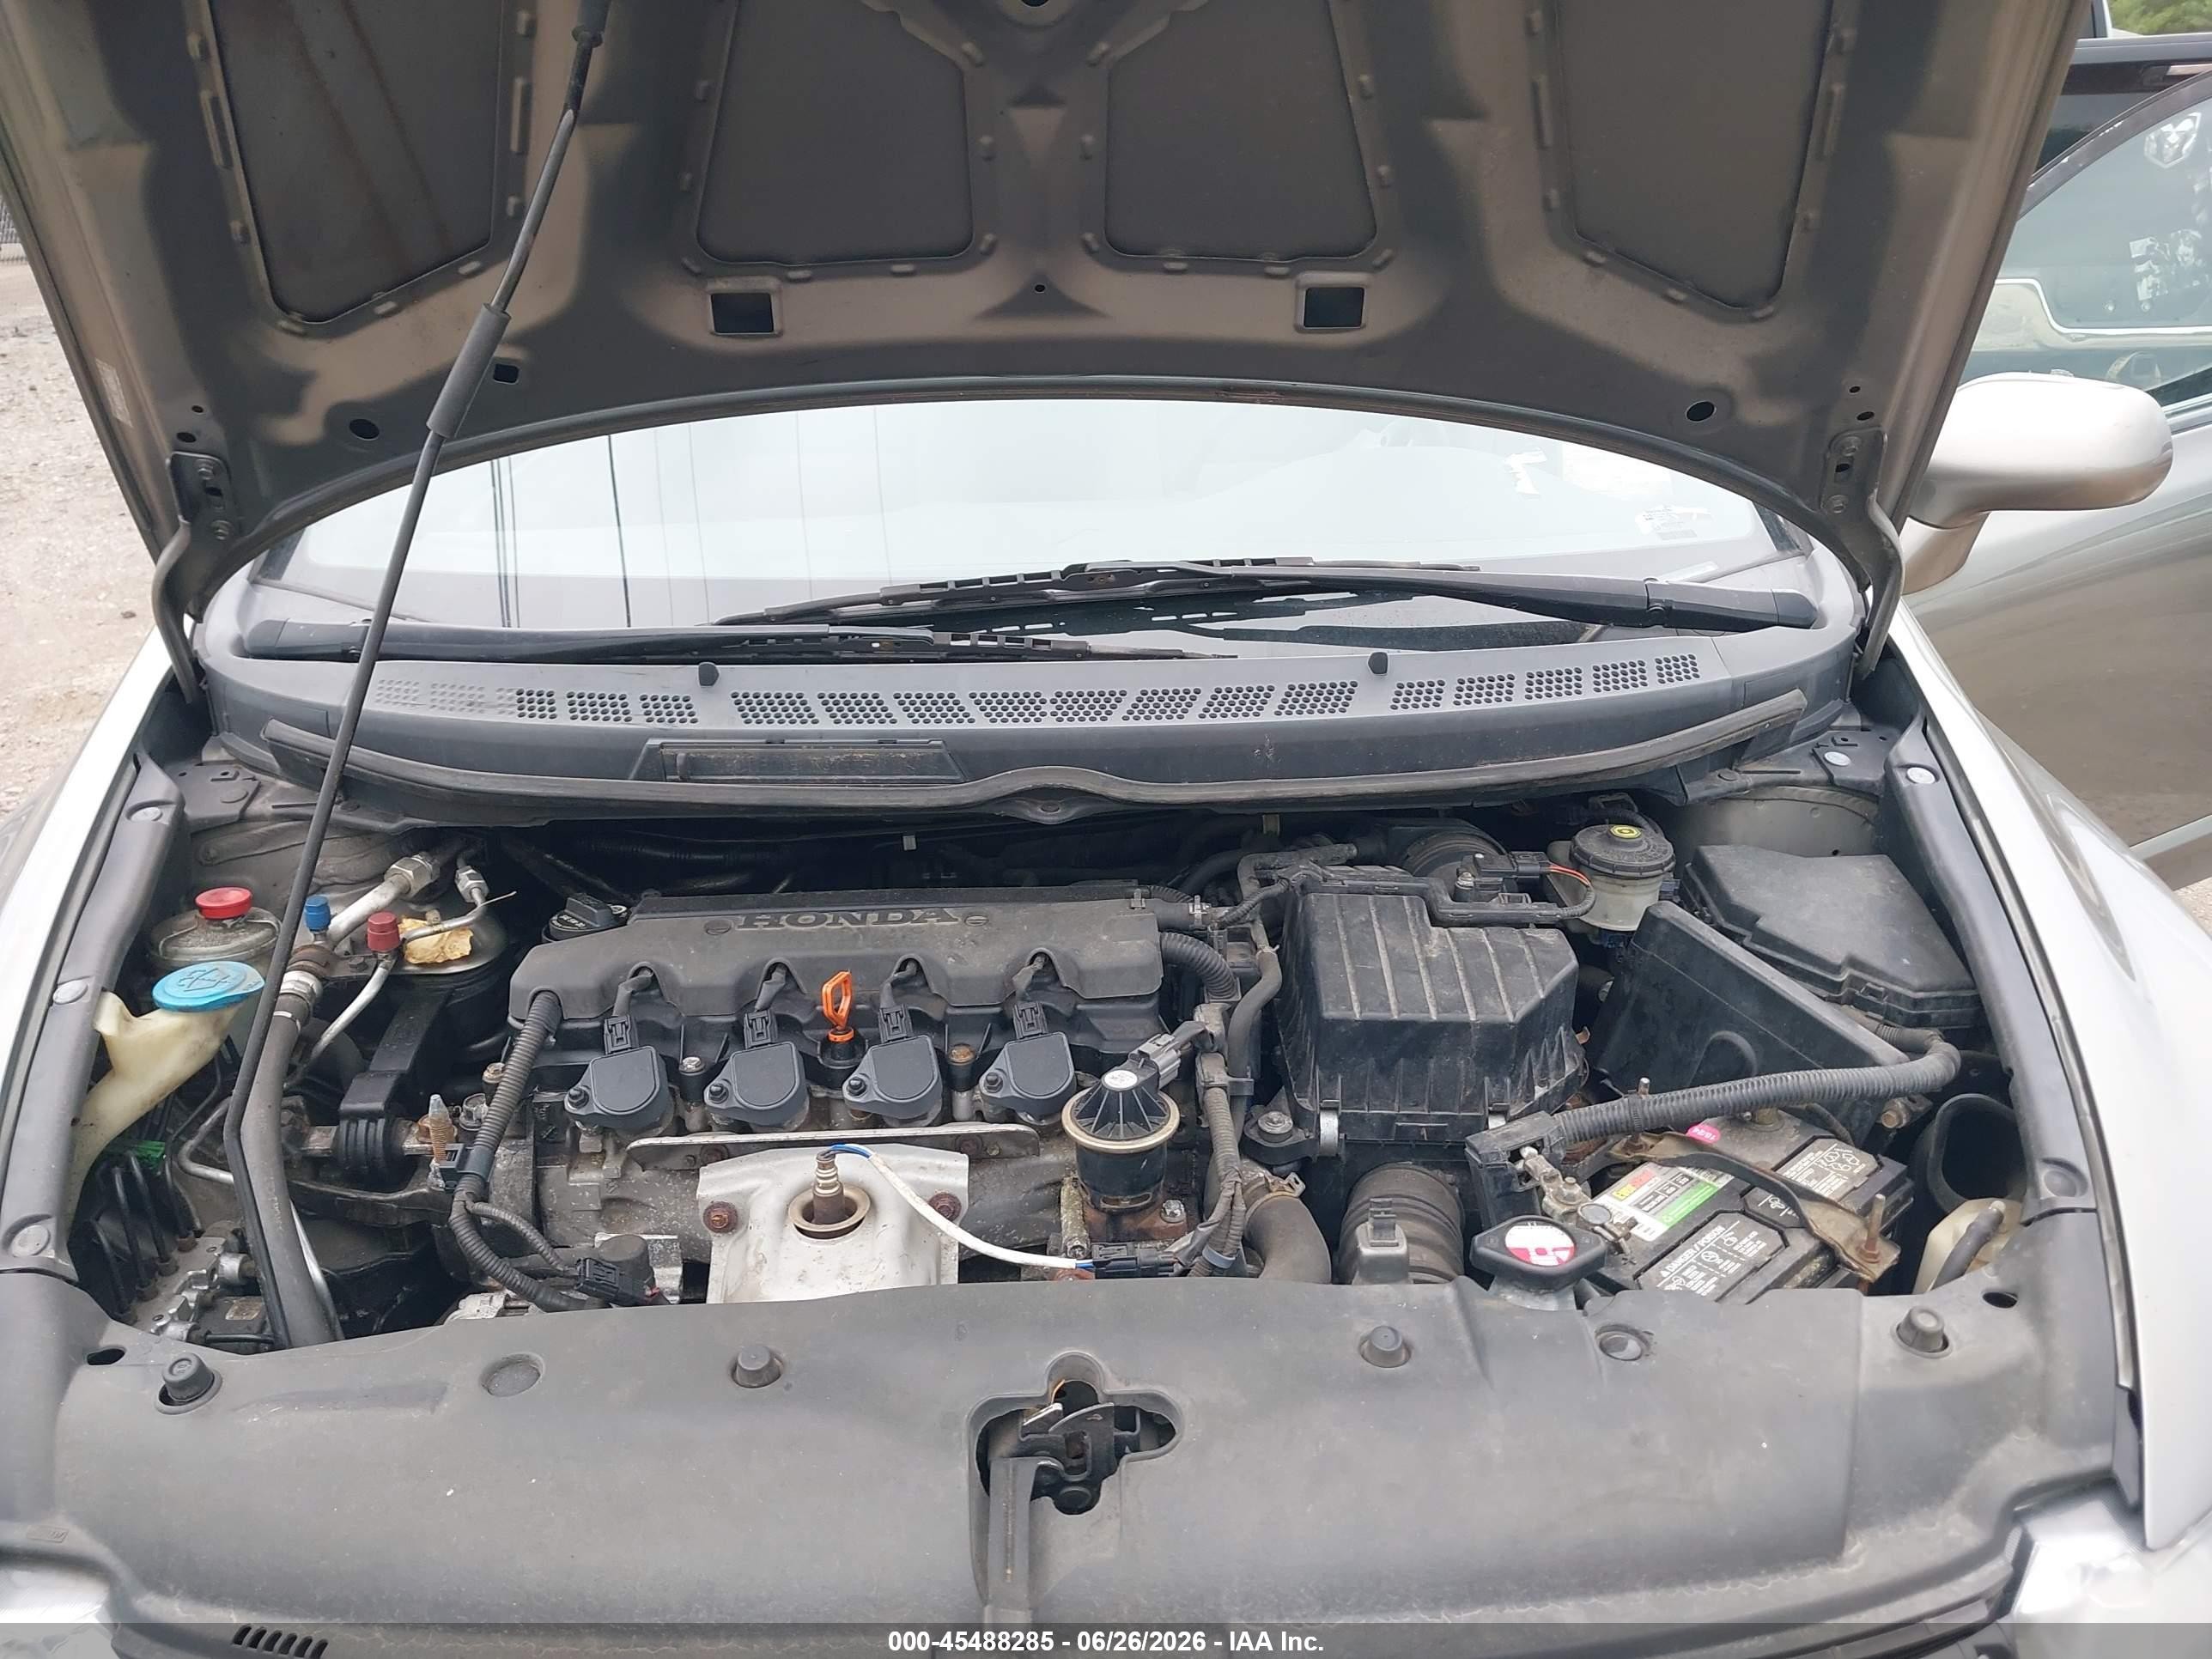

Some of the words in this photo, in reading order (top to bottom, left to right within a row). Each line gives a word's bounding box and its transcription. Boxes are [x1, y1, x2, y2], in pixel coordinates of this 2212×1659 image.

[736, 908, 961, 931] HONDA
[1664, 1249, 1698, 1273] DANGER
[1696, 1224, 1726, 1247] POISON
